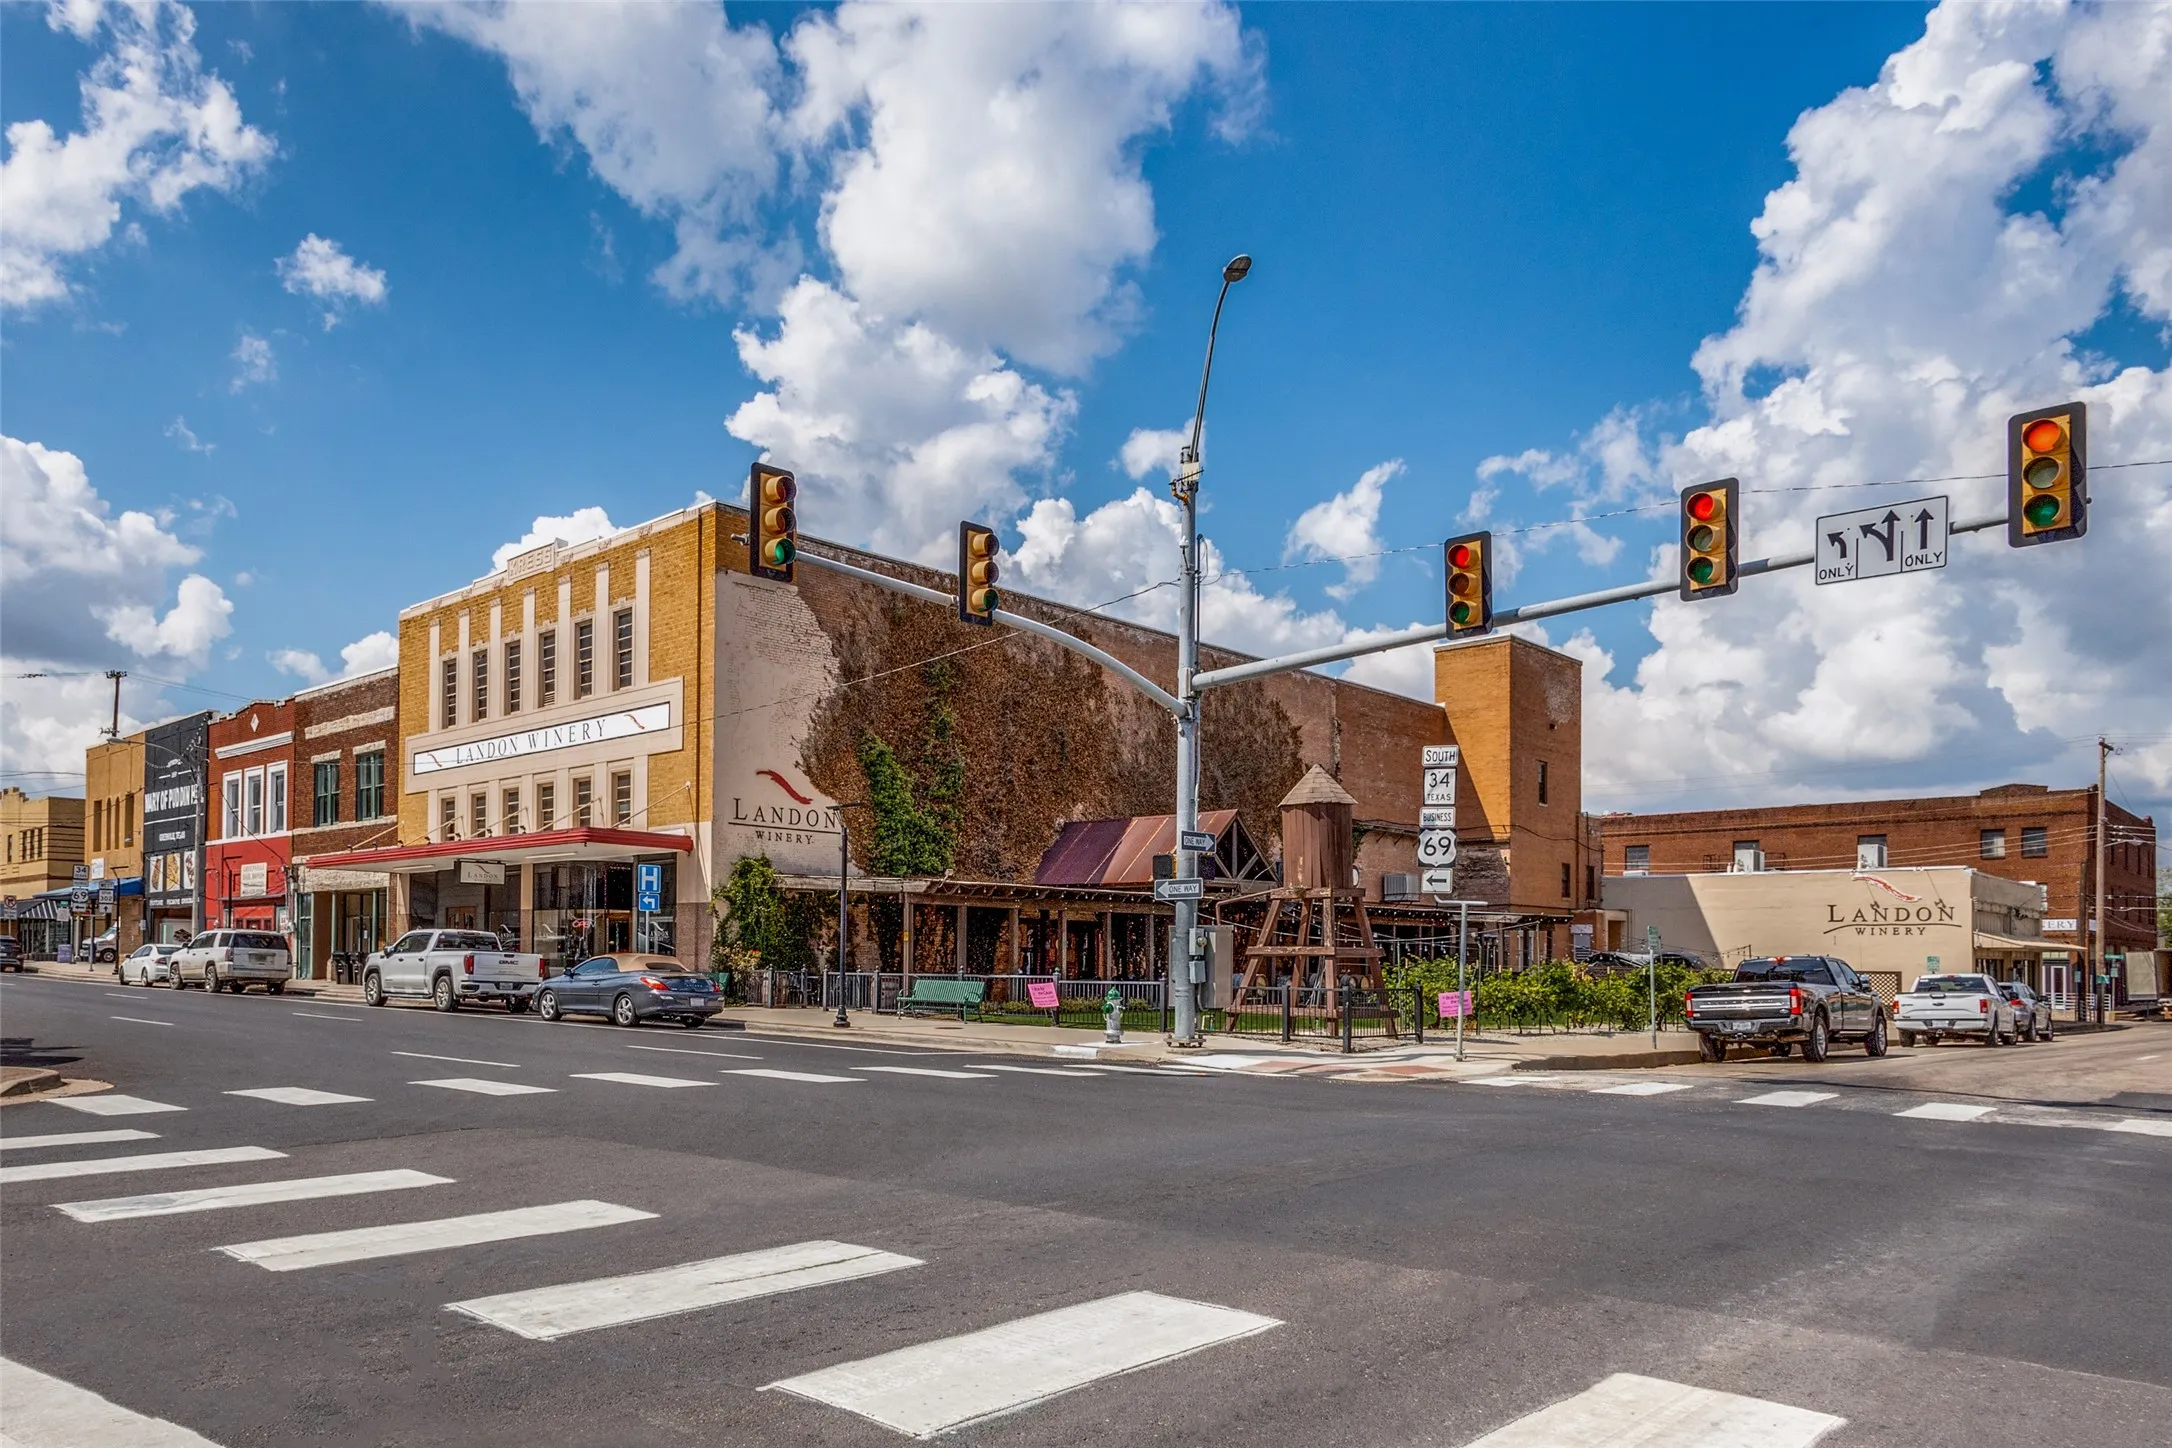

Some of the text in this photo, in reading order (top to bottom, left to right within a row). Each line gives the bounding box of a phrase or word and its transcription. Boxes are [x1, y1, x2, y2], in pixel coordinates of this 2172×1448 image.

[509, 547, 552, 577] KRESS
[1904, 551, 1943, 567] ONLY
[1819, 564, 1854, 580] ONLY
[456, 719, 606, 764] LANDON WINERY
[1425, 750, 1456, 763] SOUTH
[1429, 772, 1450, 788] 34
[1427, 793, 1452, 801] TEXAS
[1423, 812, 1452, 822] BUSINESS
[756, 830, 814, 844] WINERY
[1184, 836, 1206, 846] ONE WAY
[1423, 836, 1452, 857] 69
[467, 871, 499, 879] LANDON
[641, 867, 658, 891] H
[1168, 884, 1198, 893] ONE WAY
[73, 891, 87, 900] 69
[1827, 904, 1956, 922] LANDON
[2043, 920, 2075, 929] ERY
[1855, 927, 1927, 936] WINERY
